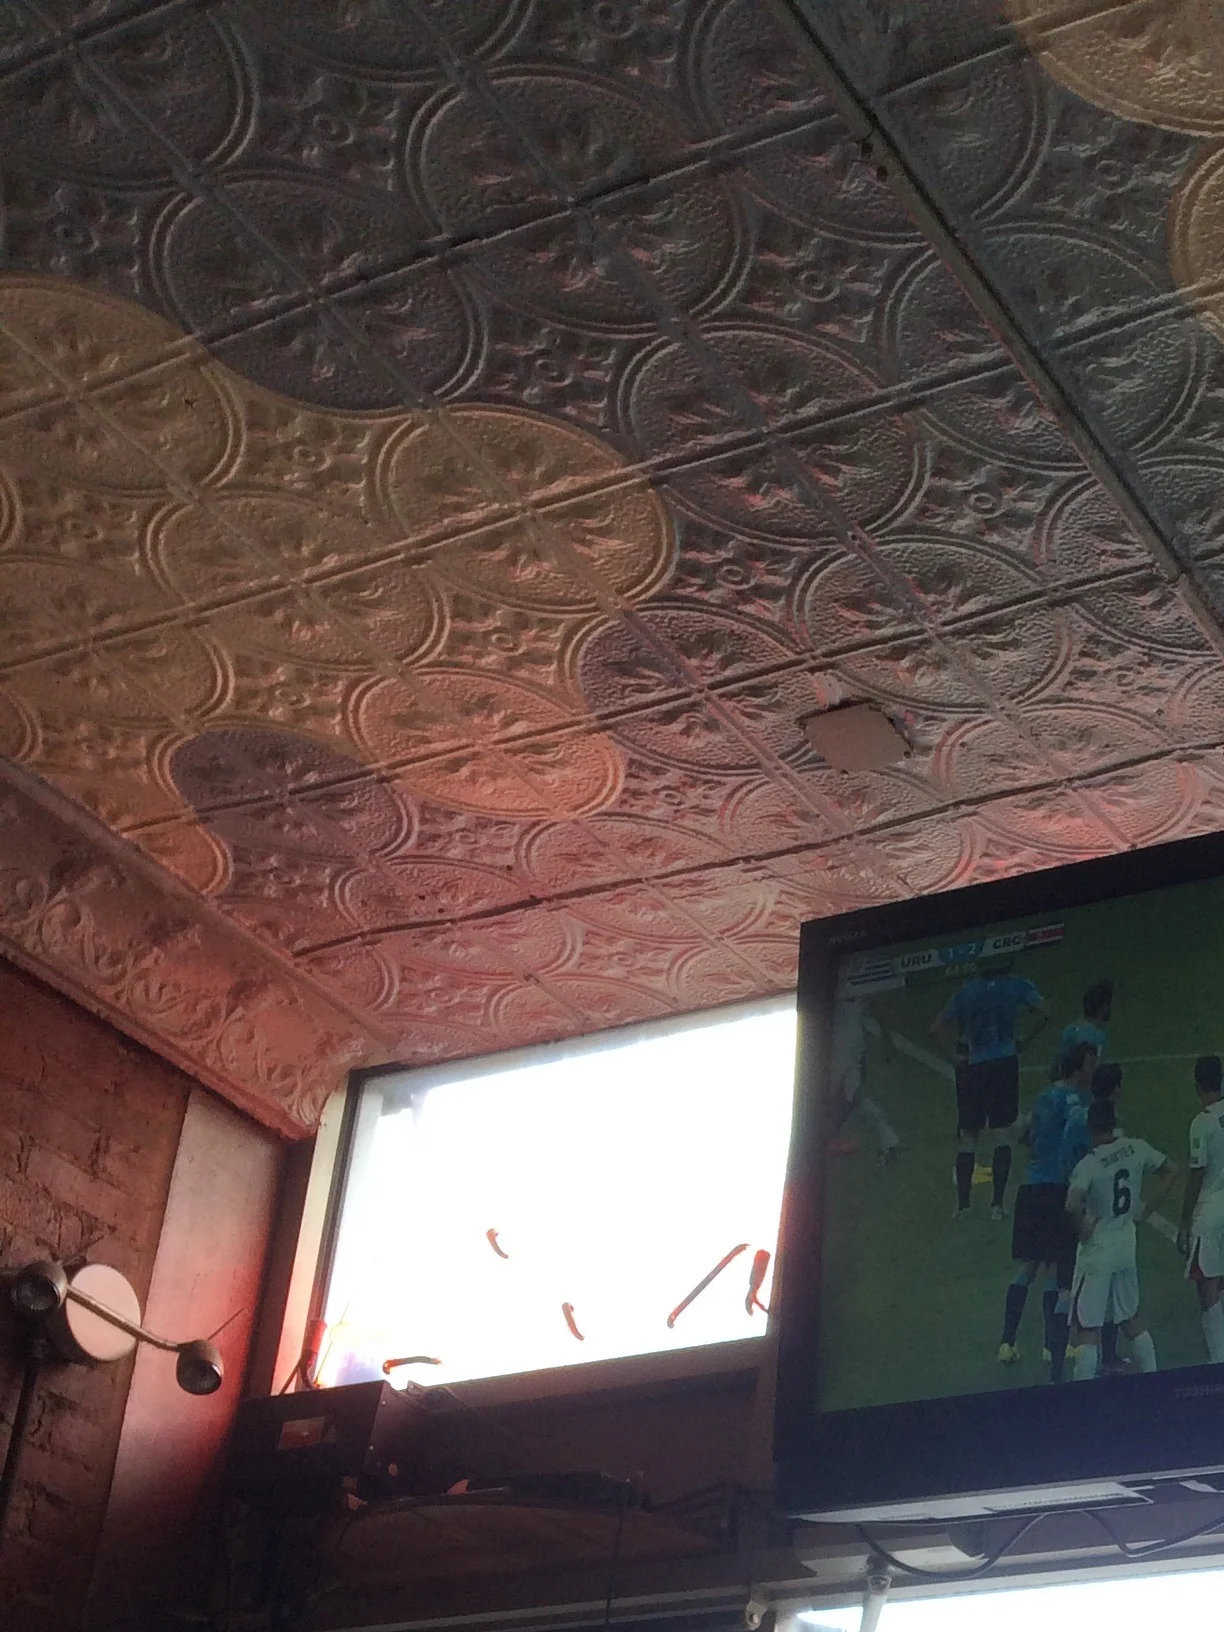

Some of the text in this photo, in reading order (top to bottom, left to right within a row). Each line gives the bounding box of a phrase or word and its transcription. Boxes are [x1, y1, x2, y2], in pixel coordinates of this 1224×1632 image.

[901, 953, 932, 968] URU
[993, 936, 1021, 949] CRC
[1112, 1169, 1131, 1217] 6
